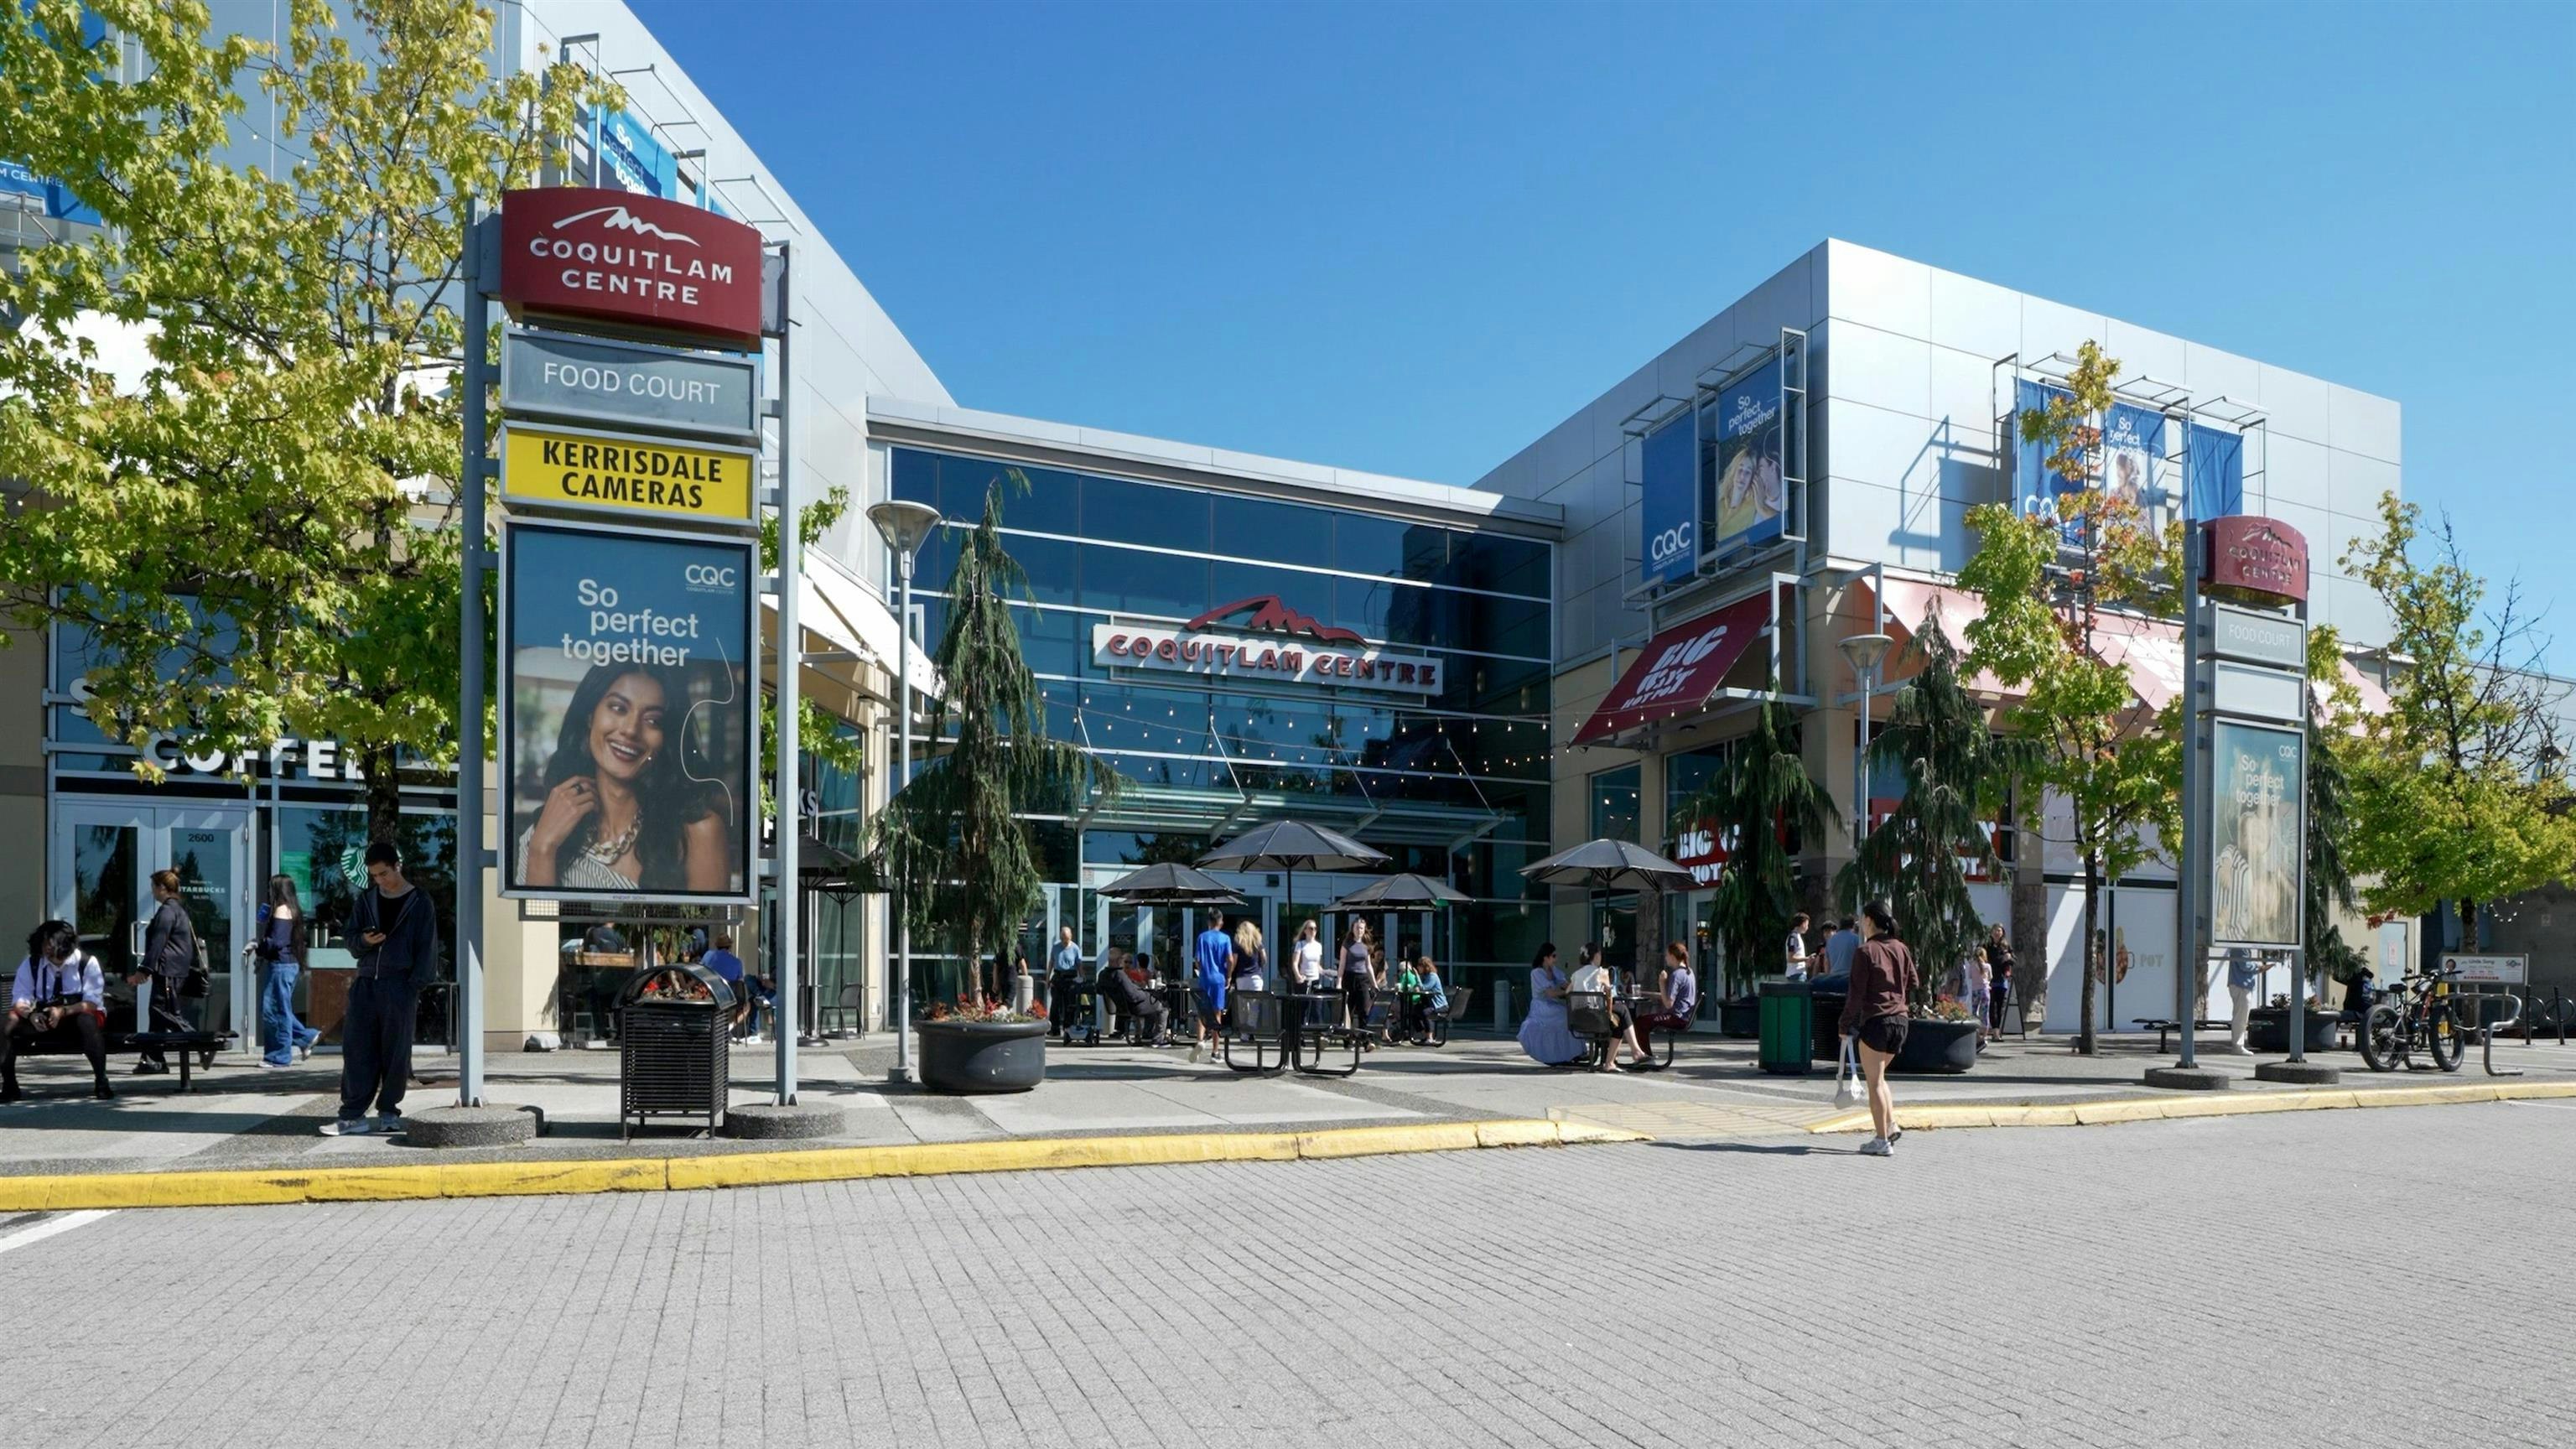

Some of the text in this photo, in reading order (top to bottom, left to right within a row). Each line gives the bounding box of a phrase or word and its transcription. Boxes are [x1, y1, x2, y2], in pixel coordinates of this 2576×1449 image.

[616, 123, 633, 151] So
[603, 133, 646, 184] perfect
[529, 236, 733, 285] COQUITLAM
[562, 268, 699, 305] CENTRE
[544, 362, 721, 404] FOOD COURT
[1728, 400, 1761, 432] perfect
[1737, 395, 1751, 410] So
[1738, 406, 1776, 436] together
[2118, 417, 2132, 431] So
[543, 440, 723, 483] KERRISDALE
[561, 471, 704, 509] CAMERAS
[1651, 522, 1690, 560] CQC
[2228, 546, 2300, 571] COQUITLAM
[685, 564, 735, 587] CQC
[2242, 565, 2293, 584] CENTRE
[577, 579, 619, 608] So
[590, 608, 699, 638] perfect
[2229, 624, 2292, 647] FOOD COURT
[561, 633, 690, 667] together
[1109, 634, 1436, 686] COQUITLAM CENTRE
[1649, 625, 1728, 674] BIG
[1620, 692, 1654, 710] HOT
[2241, 755, 2256, 771] So
[2278, 745, 2298, 758] CQC
[2246, 773, 2284, 790] perfect
[2236, 788, 2281, 808] together
[188, 834, 214, 843] 2600
[1679, 829, 1713, 860] BIG
[1690, 862, 1722, 883] HOT
[2140, 954, 2164, 968] POT
